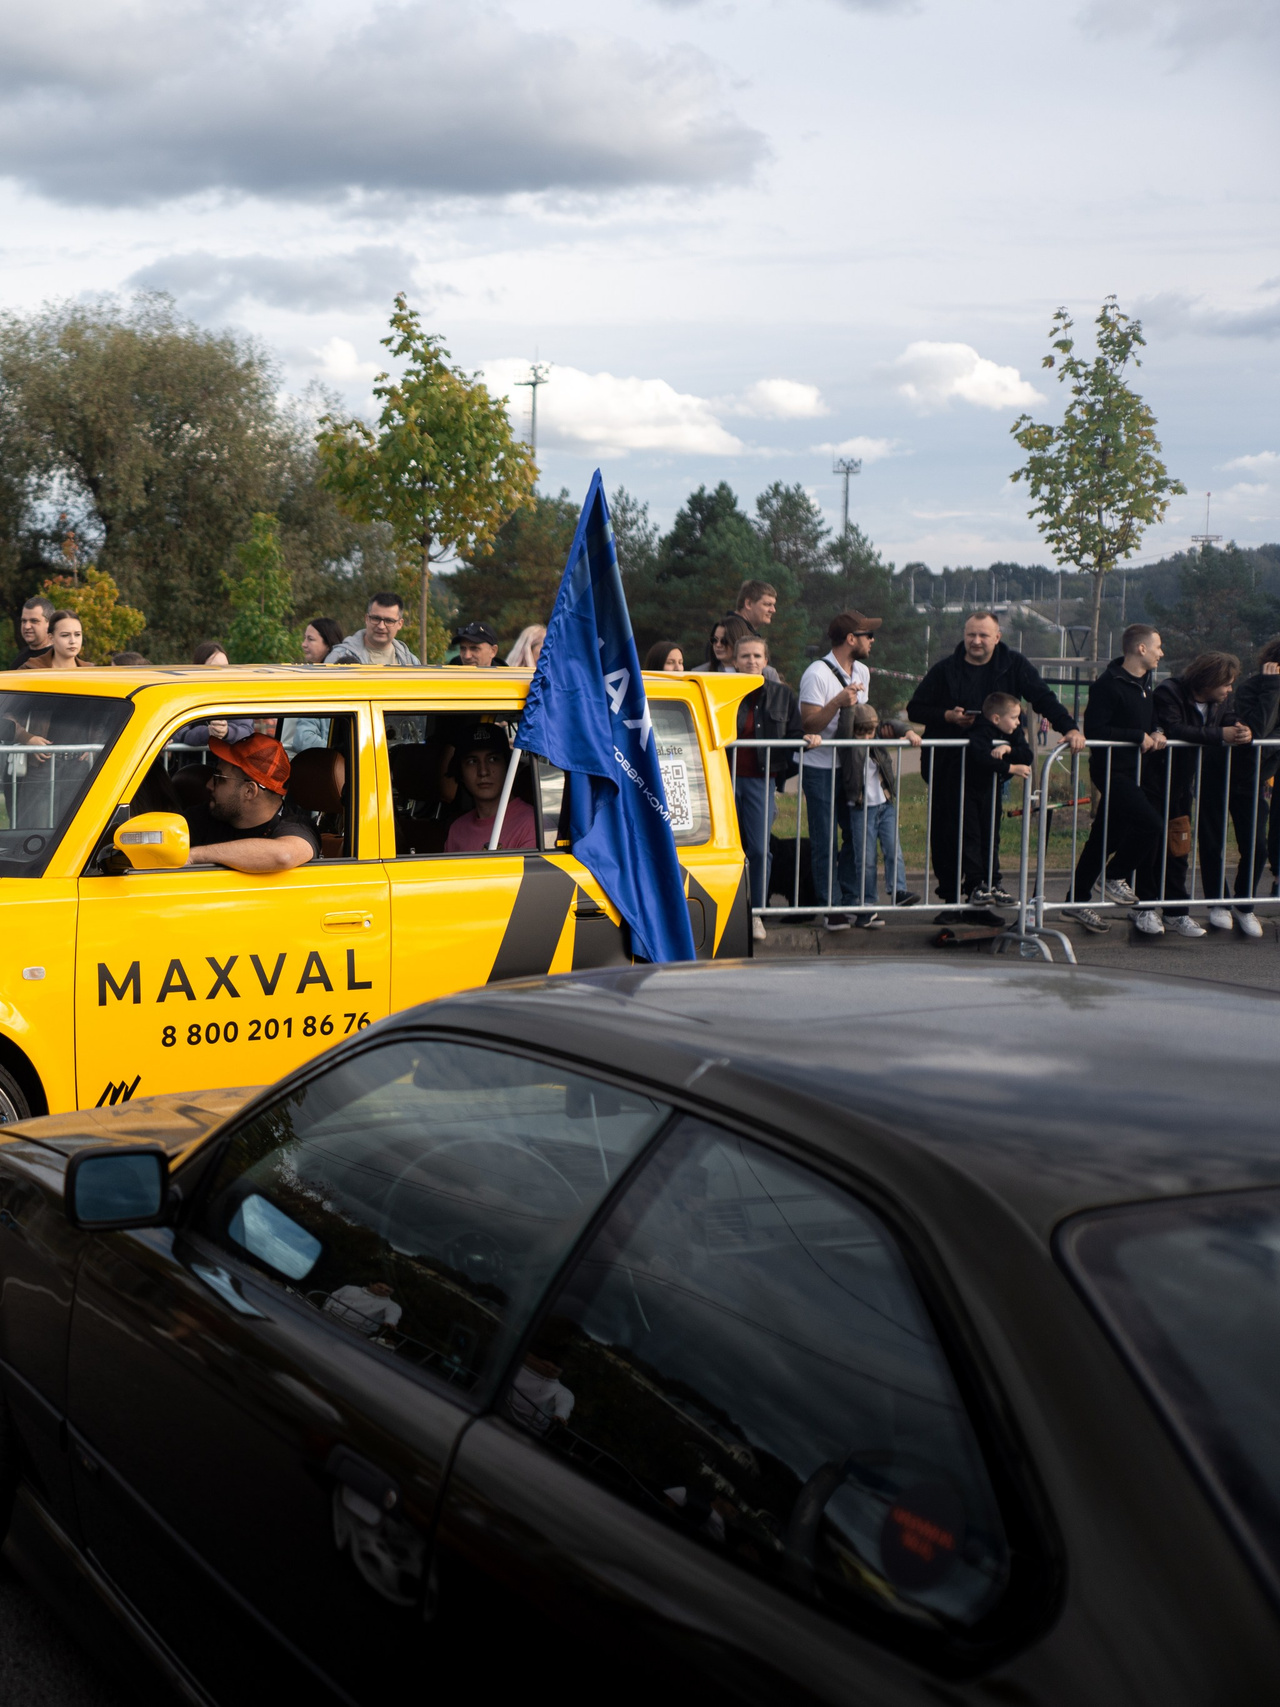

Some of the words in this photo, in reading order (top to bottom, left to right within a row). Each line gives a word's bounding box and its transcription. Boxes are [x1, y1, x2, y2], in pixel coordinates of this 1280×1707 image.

[598, 637, 653, 752] AX
[613, 745, 645, 788] овая
[656, 744, 683, 756] al.site
[97, 948, 373, 1007] MAXVAL
[161, 1025, 177, 1048] 8
[186, 1020, 239, 1046] 800
[247, 1017, 293, 1041] 201
[302, 1014, 335, 1037] 86
[342, 1011, 372, 1034] 76
